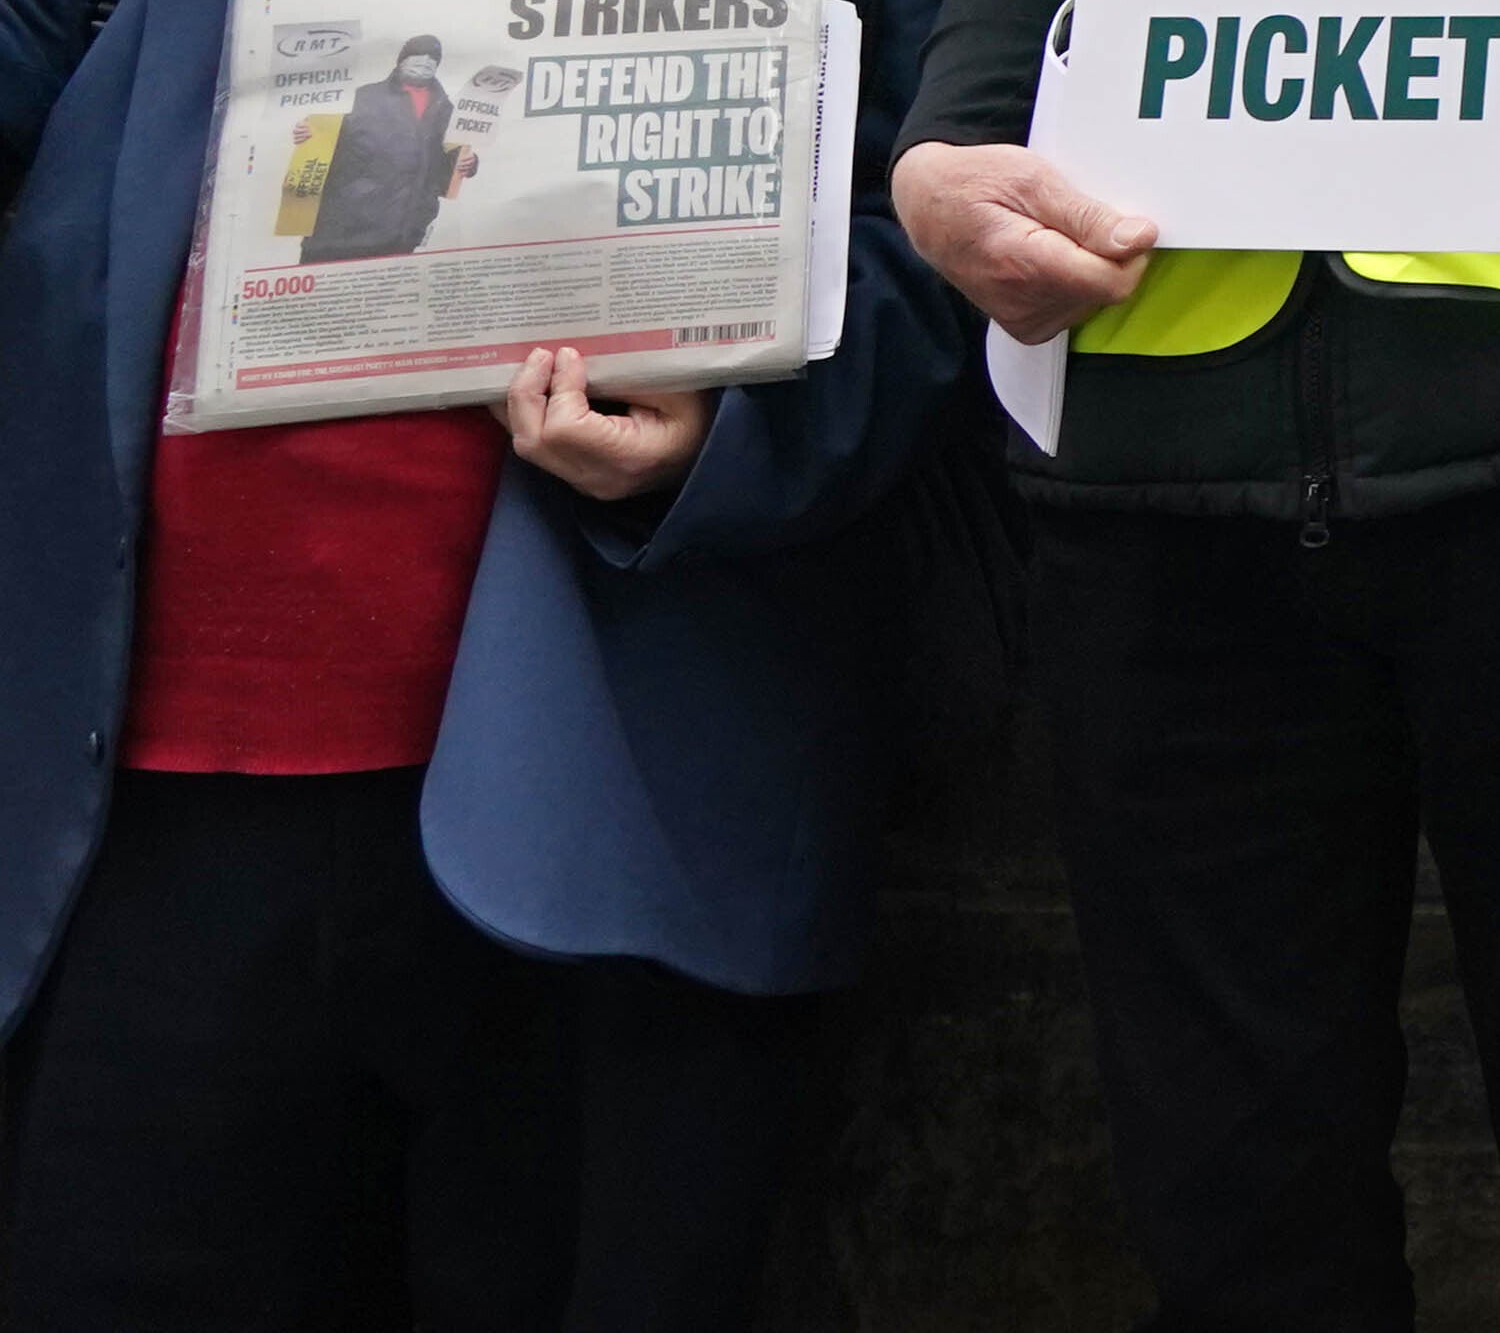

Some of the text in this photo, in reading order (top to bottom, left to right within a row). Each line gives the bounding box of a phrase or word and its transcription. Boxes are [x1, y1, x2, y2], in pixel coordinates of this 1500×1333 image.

[276, 68, 352, 87] OFFICIAL
[531, 50, 780, 111] DEFEND THE
[280, 89, 344, 107] PICKET
[457, 99, 500, 117] OFFICIAL
[456, 118, 492, 133] PICKET
[585, 107, 778, 164] RIGHT TO
[623, 165, 777, 223] STRIKE
[242, 274, 315, 300] 50,000
